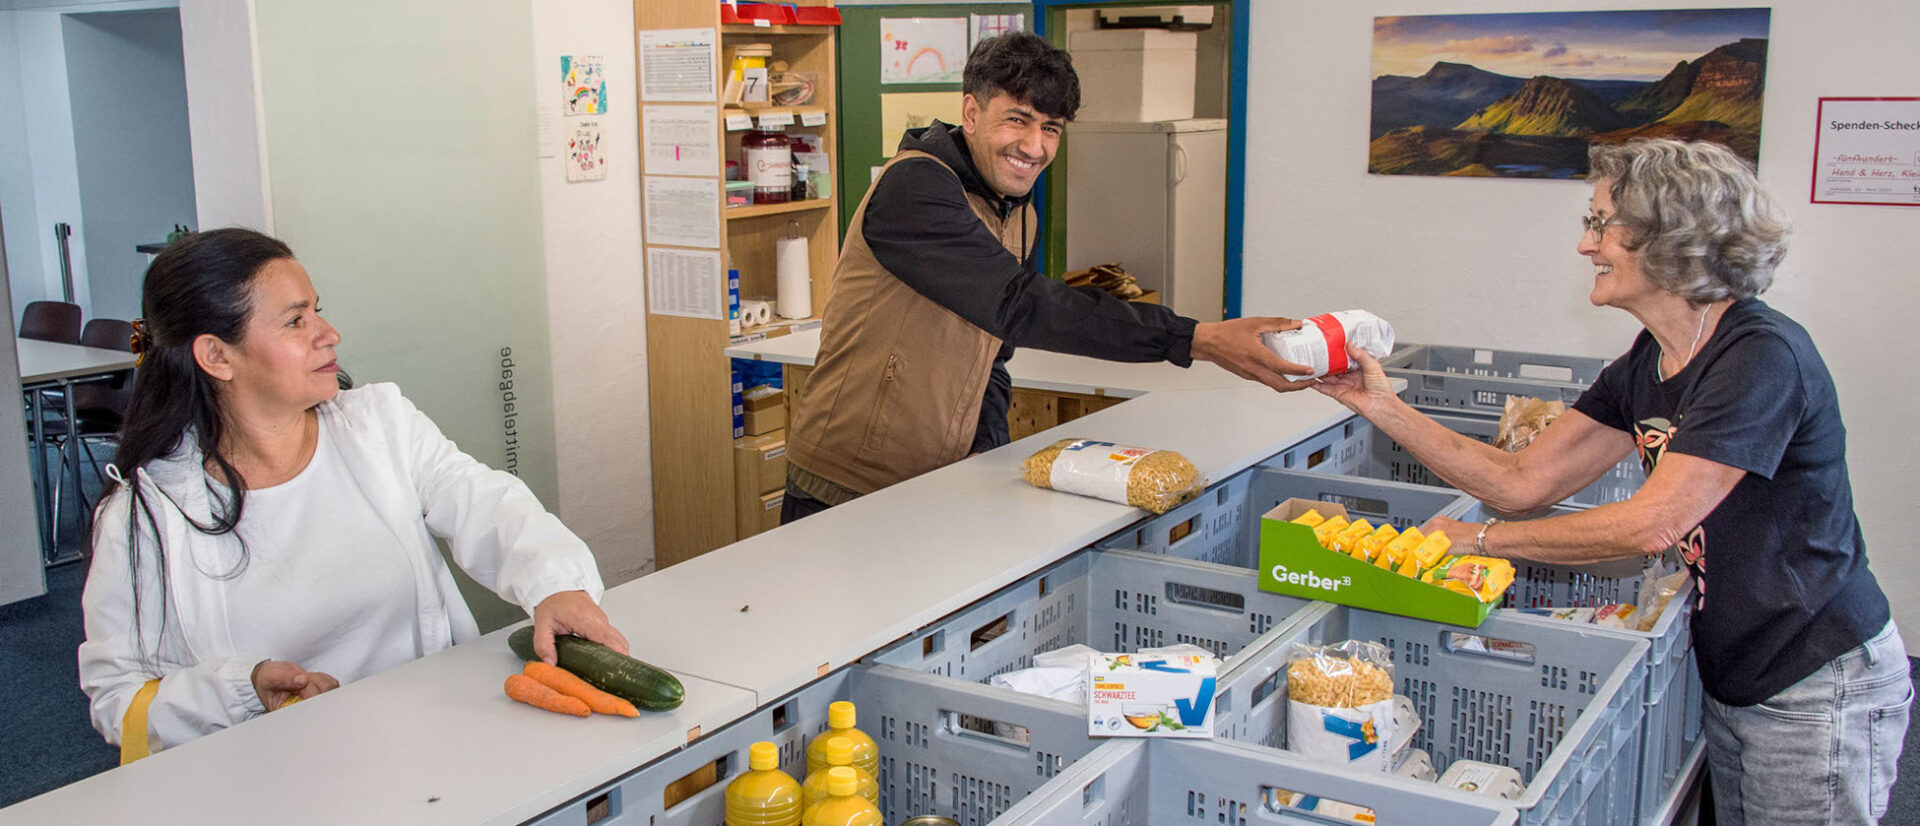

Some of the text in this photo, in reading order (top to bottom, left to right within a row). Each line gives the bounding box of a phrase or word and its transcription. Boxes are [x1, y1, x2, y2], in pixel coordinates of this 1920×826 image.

[746, 77, 758, 94] 7
[1830, 120, 1920, 132] Spenden-Scheck
[1831, 168, 1856, 177] Hand
[1859, 169, 1867, 177] &
[1901, 169, 1920, 178] Klei
[1271, 564, 1342, 592] Gerber
[1093, 690, 1136, 700] SCHWARZTEE
